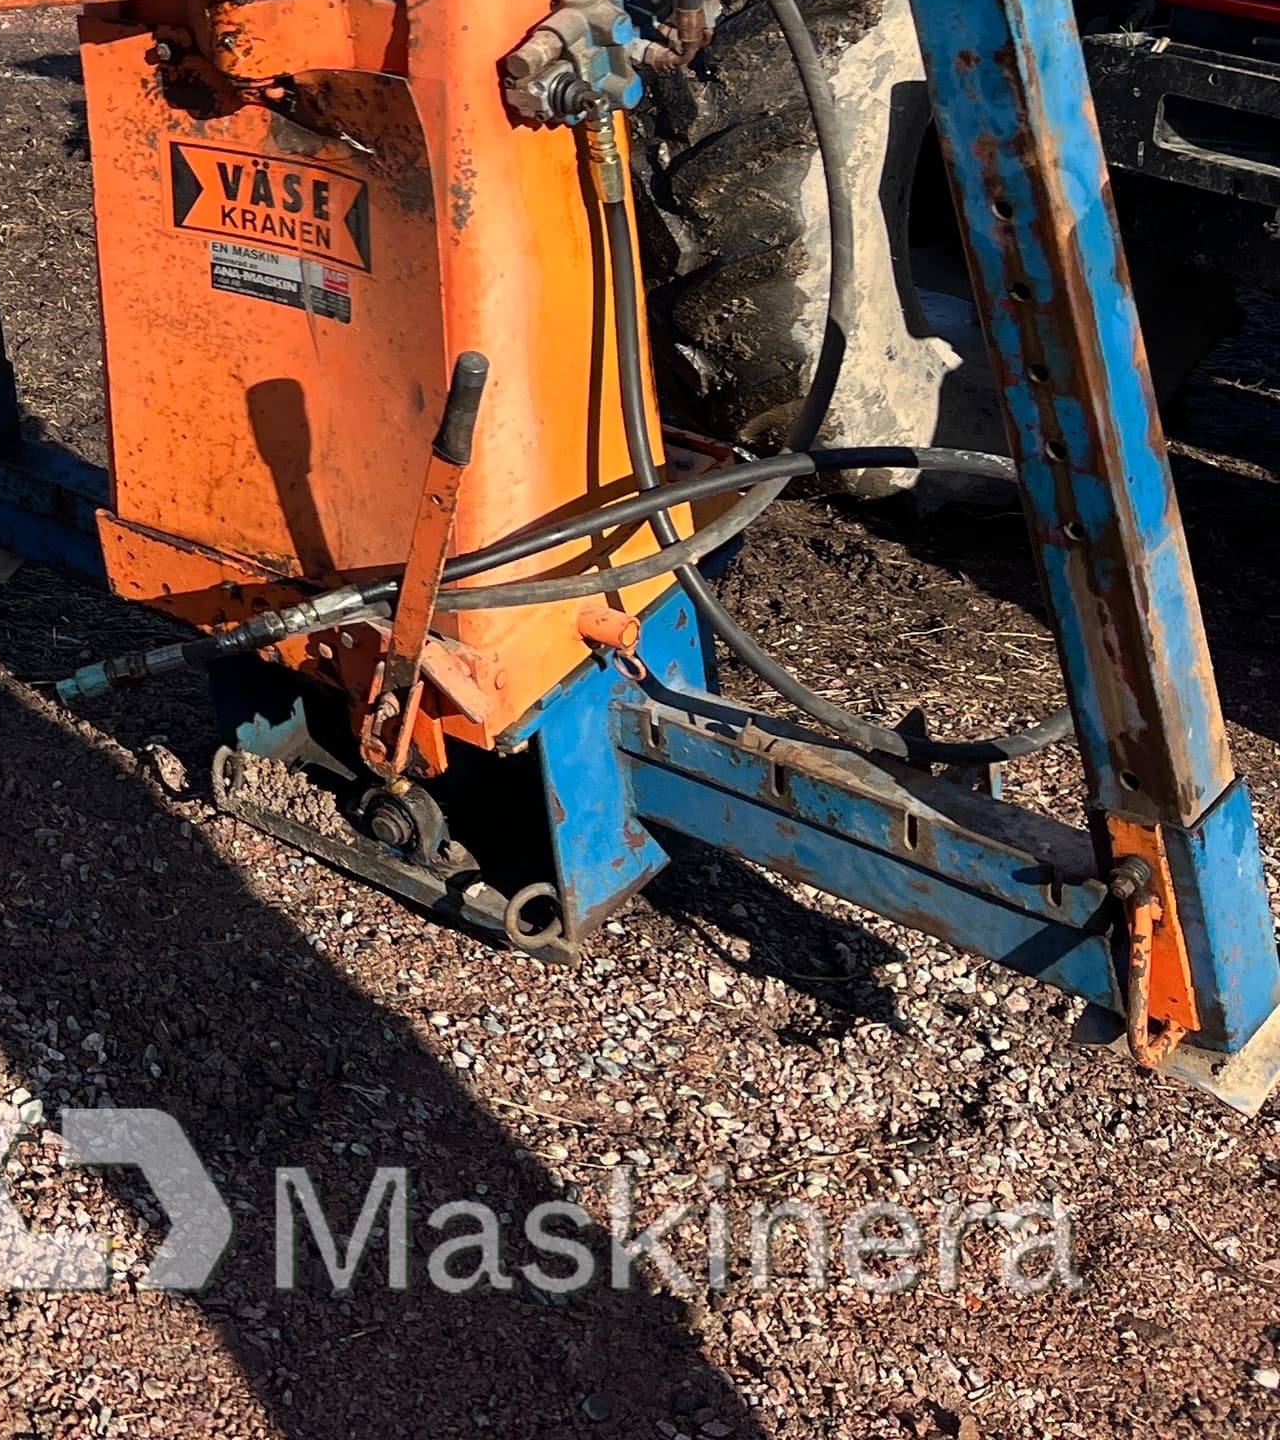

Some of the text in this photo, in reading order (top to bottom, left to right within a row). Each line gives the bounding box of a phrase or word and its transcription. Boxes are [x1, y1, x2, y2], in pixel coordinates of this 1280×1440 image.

[216, 159, 330, 222] VÄSE
[220, 204, 332, 250] KRANEN
[211, 241, 280, 265] EN MASKIN
[213, 264, 299, 293] ANA-MASKIN
